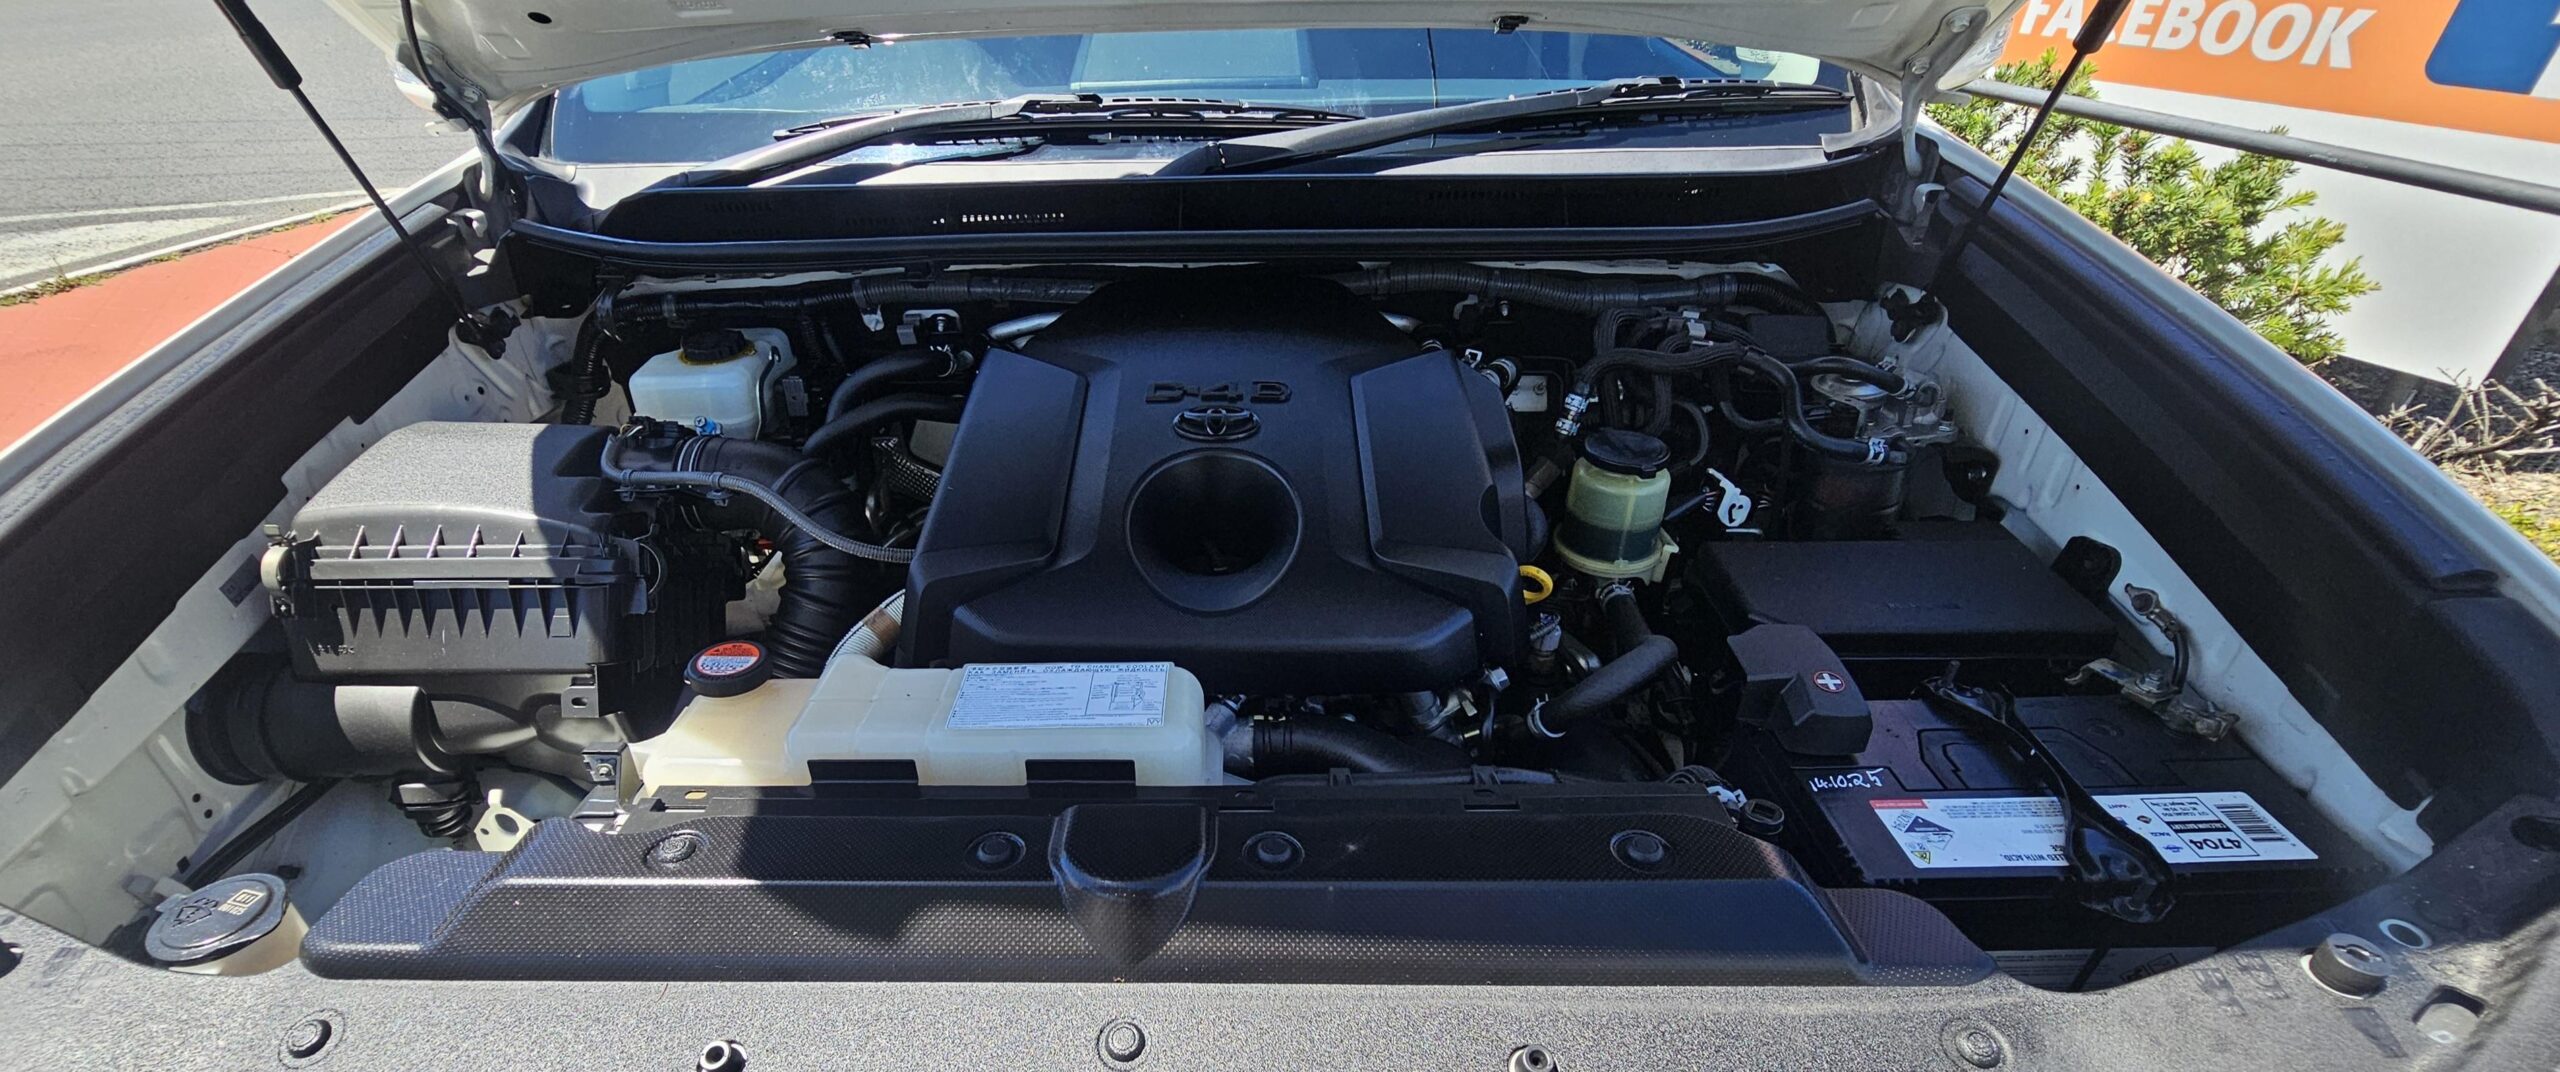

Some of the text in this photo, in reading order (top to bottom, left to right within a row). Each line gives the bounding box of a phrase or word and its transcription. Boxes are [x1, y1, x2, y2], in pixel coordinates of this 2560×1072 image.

[2019, 0, 2377, 69] FAEBOOK
[1145, 381, 1292, 404] D-4D
[1809, 768, 1884, 792] 14.10.25
[2189, 838, 2242, 850] 4704
